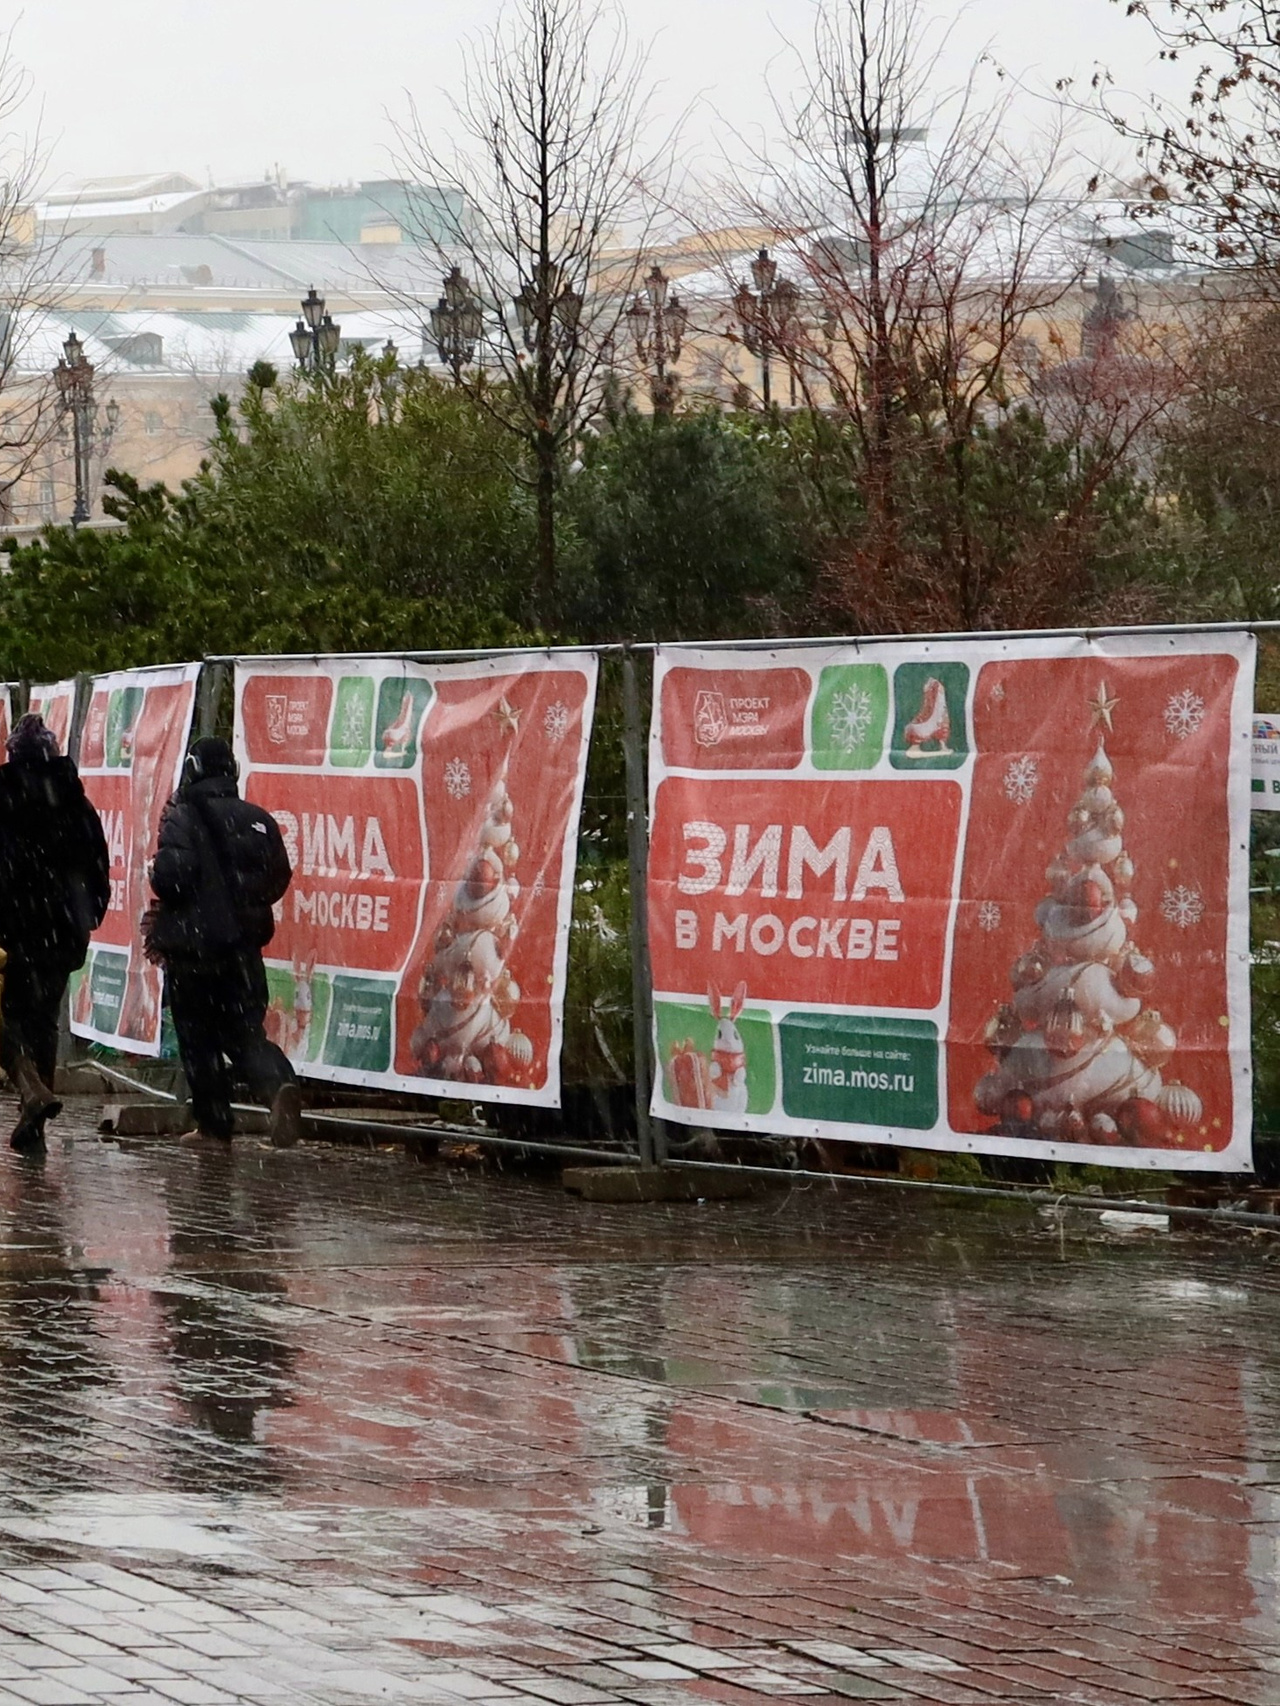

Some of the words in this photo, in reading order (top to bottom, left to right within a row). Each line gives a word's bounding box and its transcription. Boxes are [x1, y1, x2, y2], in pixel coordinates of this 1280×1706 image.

[730, 697, 770, 709] ПРОЕКТ
[677, 821, 905, 902] ЗИМА
[294, 889, 390, 932] МОСКВЕ
[675, 909, 698, 950] В
[712, 912, 901, 961] МОСКВЕ
[805, 1043, 840, 1055] Узнайте
[873, 1050, 884, 1059] на
[803, 1062, 914, 1092] zima.mos.ru
